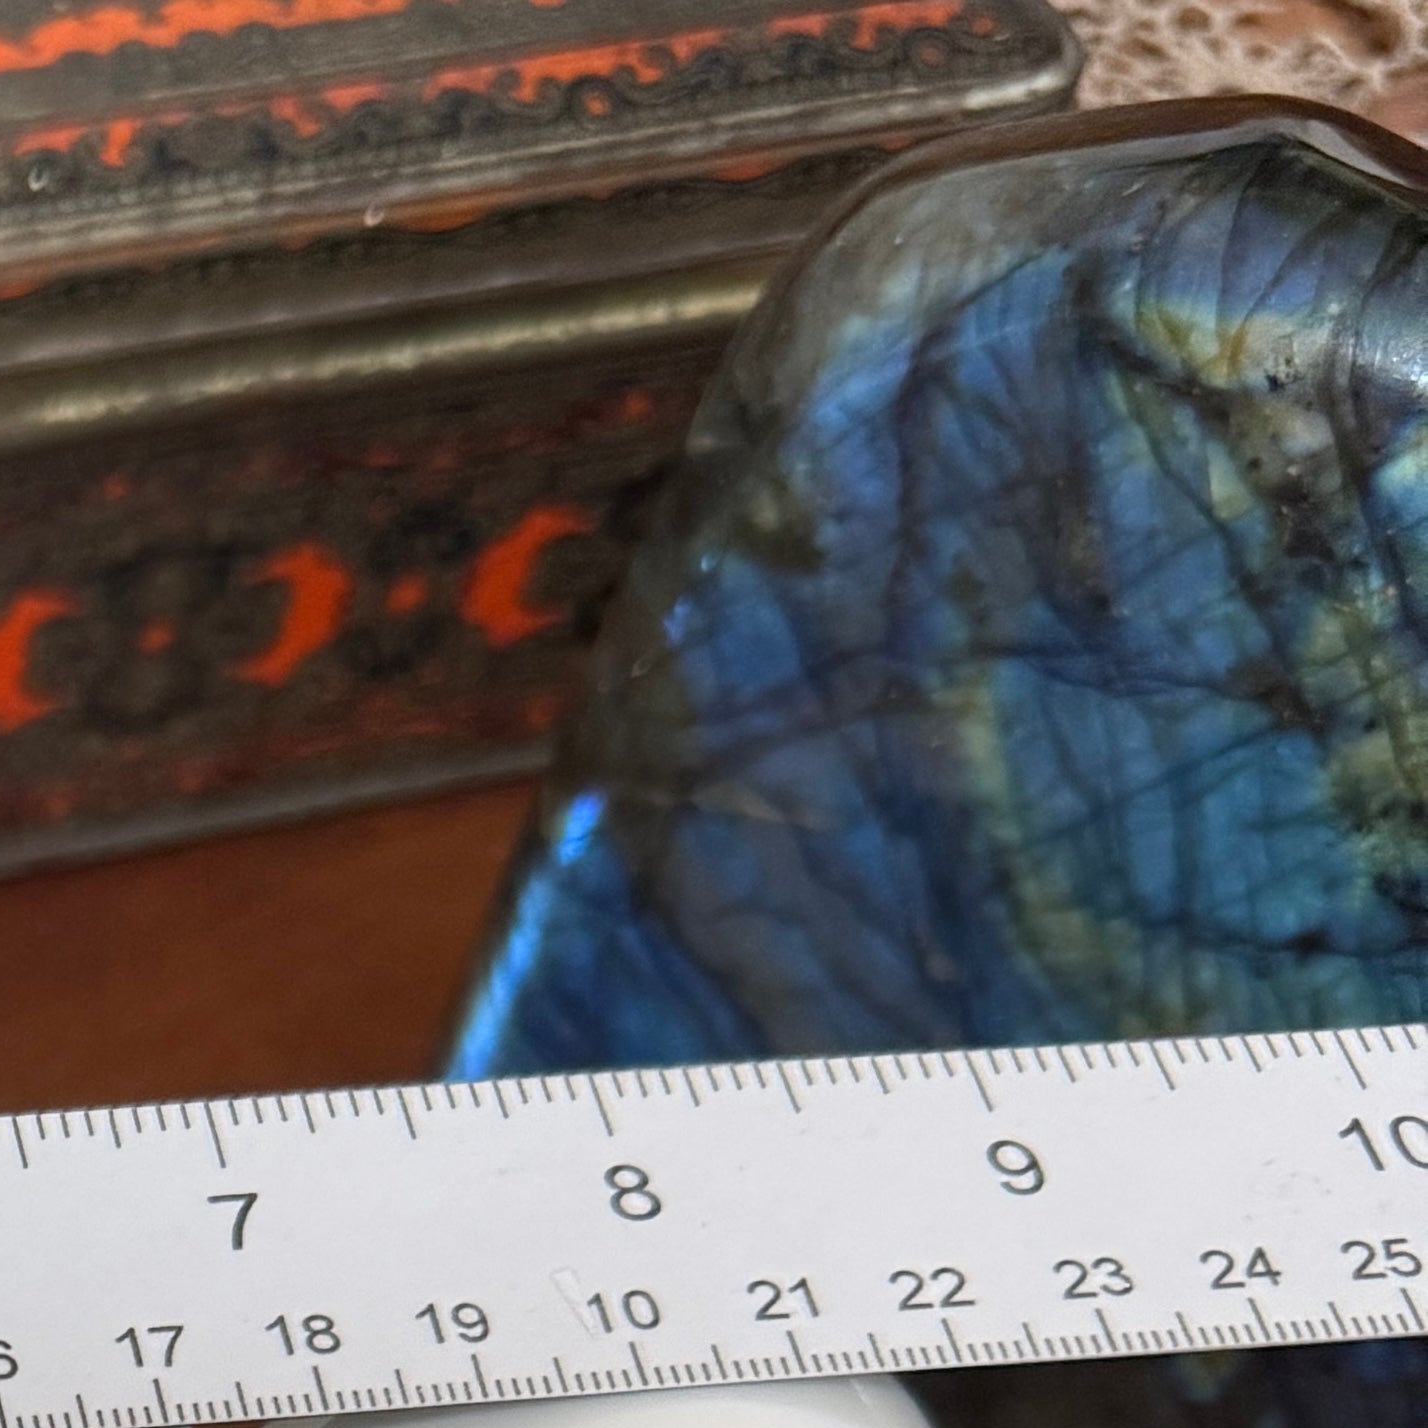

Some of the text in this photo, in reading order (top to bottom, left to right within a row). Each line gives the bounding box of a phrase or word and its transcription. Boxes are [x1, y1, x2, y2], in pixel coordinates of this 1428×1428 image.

[206, 1192, 259, 1251] 7
[603, 1164, 663, 1222] 8
[986, 1139, 1046, 1196] 9
[1338, 1115, 1428, 1172] 10
[114, 1324, 185, 1369] 17
[264, 1313, 342, 1357] 18
[414, 1302, 491, 1345] 19
[586, 1289, 661, 1334] 10
[746, 1277, 820, 1322] 21
[888, 1266, 977, 1312] 22
[1052, 1256, 1135, 1300] 23
[1199, 1246, 1283, 1291] 24
[1340, 1237, 1423, 1281] 25
